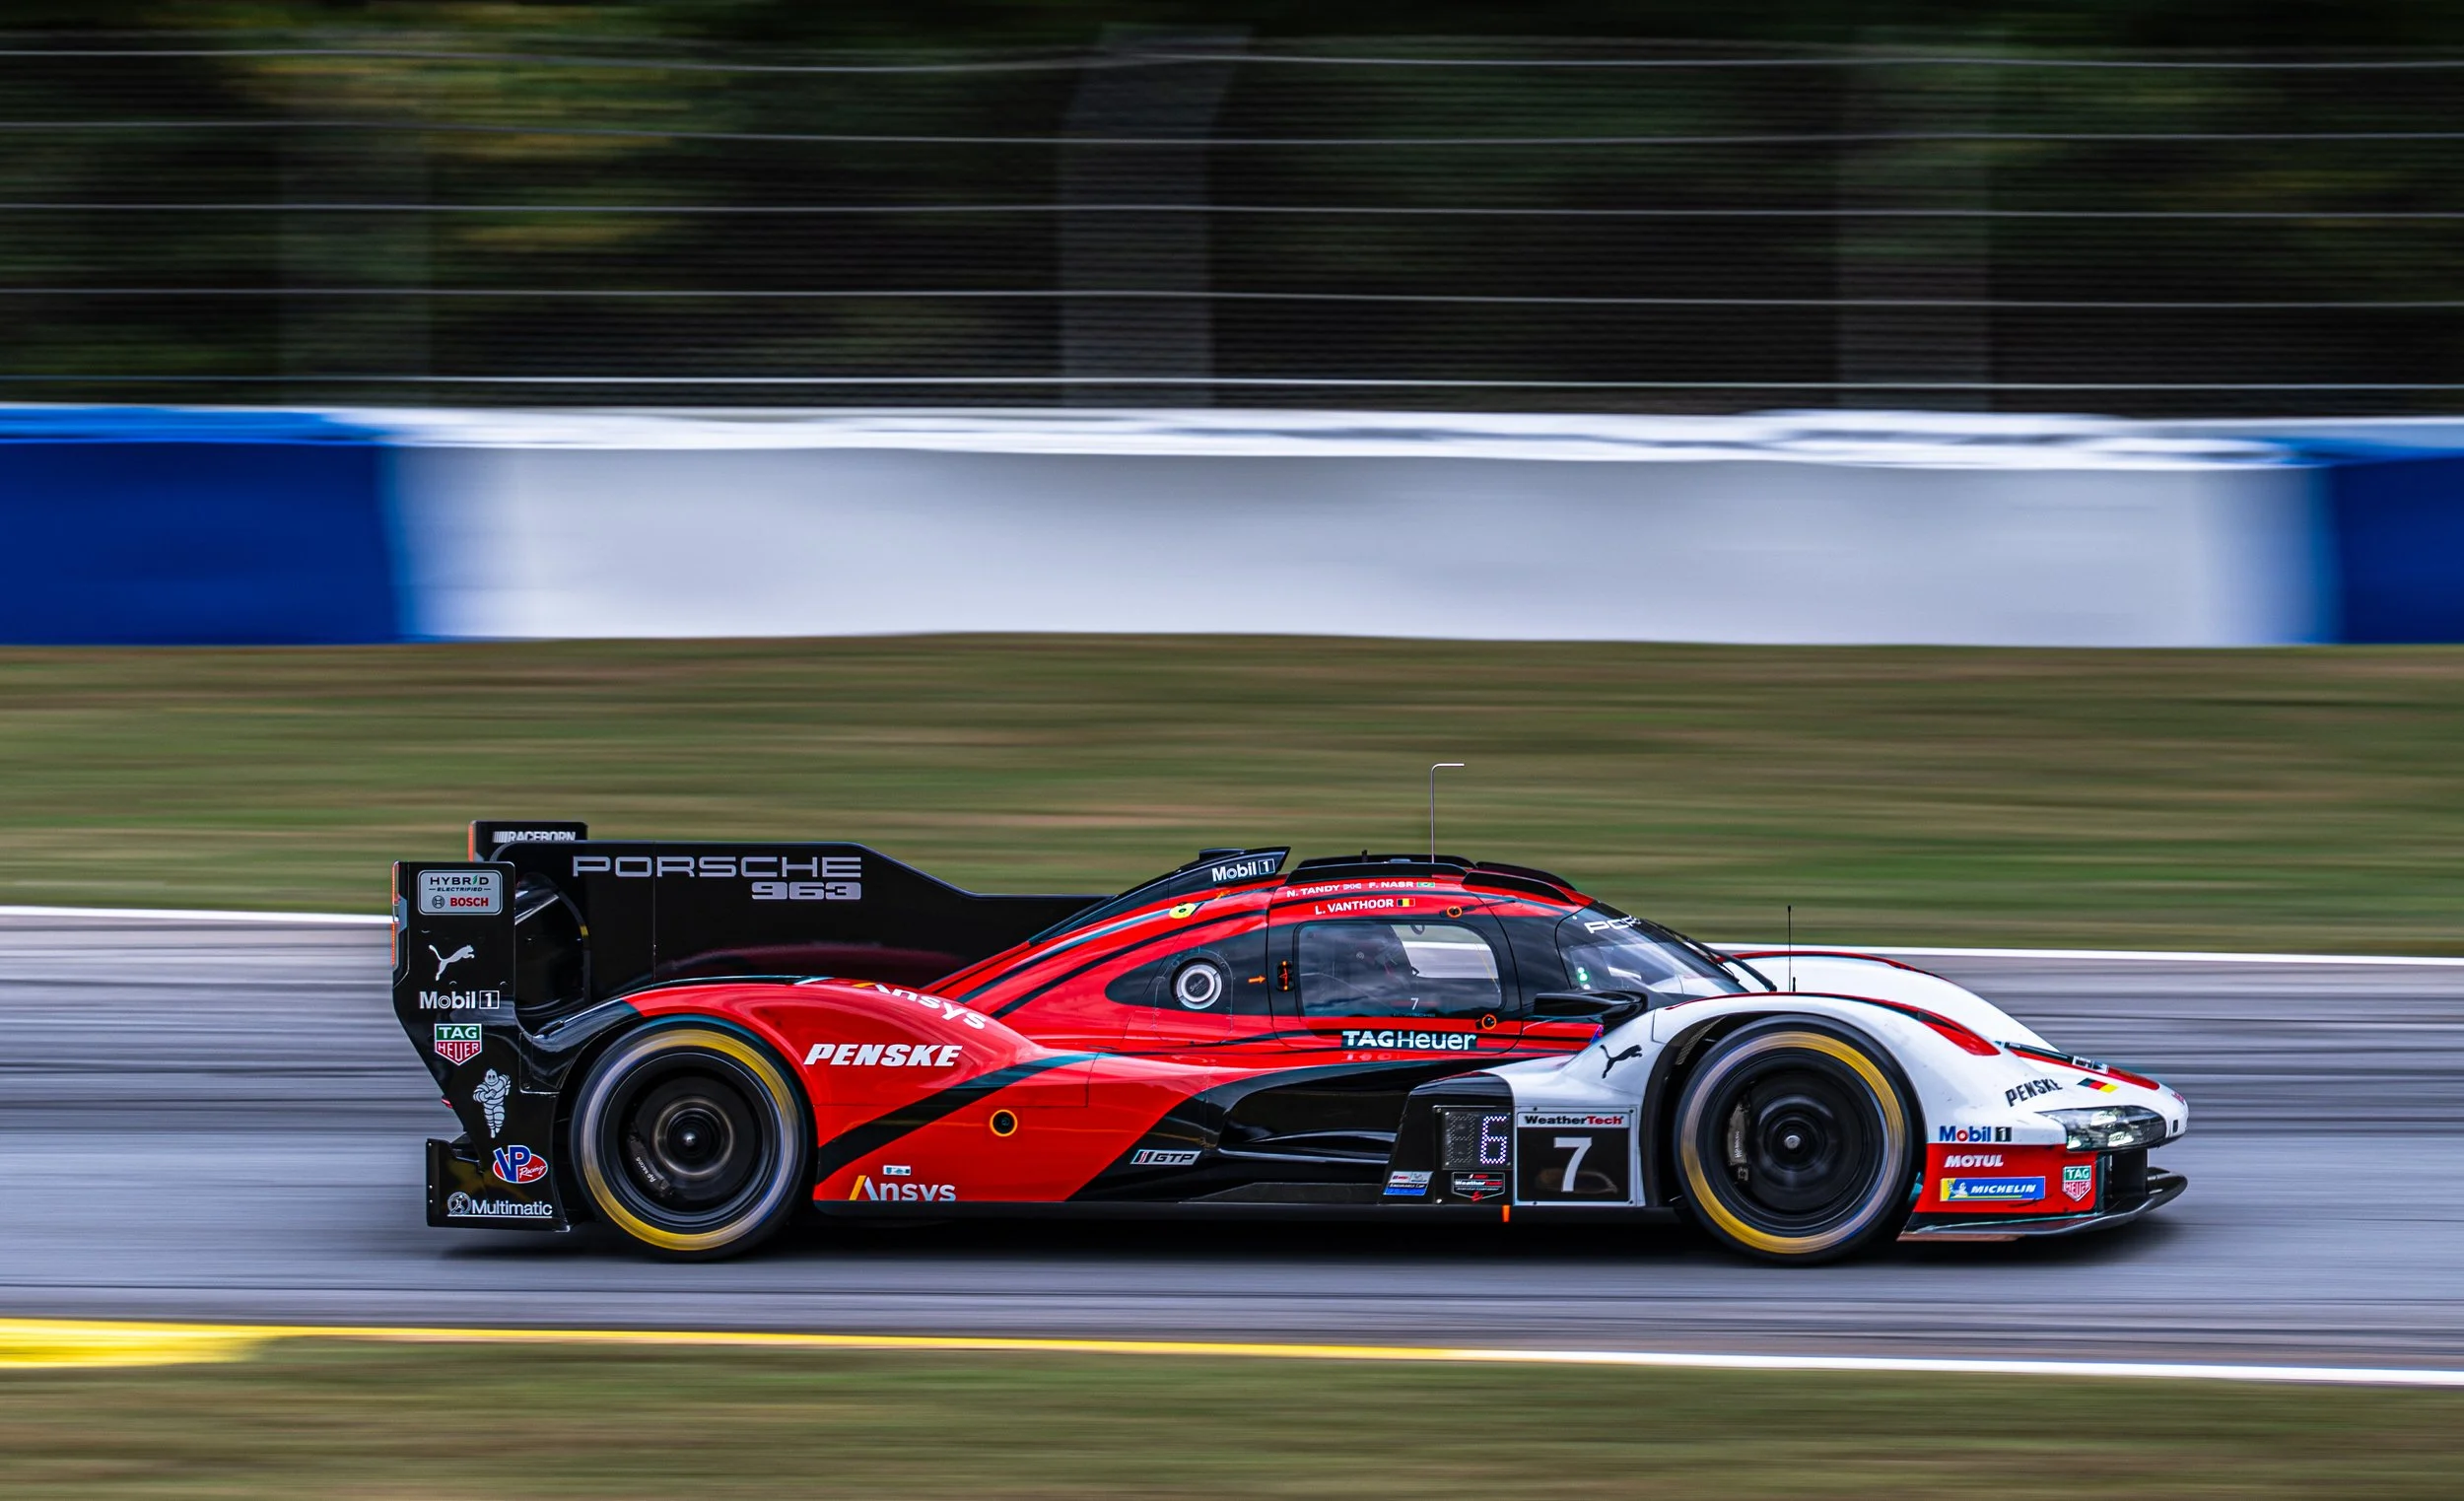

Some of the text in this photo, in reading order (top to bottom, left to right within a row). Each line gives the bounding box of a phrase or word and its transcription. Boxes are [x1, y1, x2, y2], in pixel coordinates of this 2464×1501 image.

[573, 855, 861, 877] PORSCHE
[1211, 861, 1257, 882] Mobil
[430, 875, 490, 886] HYBRID
[752, 882, 861, 900] 963
[1286, 884, 1340, 898] N. TANDY
[449, 898, 489, 907] BOSCH
[1315, 898, 1395, 916] L. VANTHOOR
[419, 990, 476, 1009] Mobil
[1410, 997, 1419, 1010] 7
[439, 1027, 477, 1039] TAG
[438, 1043, 479, 1062] HEUER
[803, 1044, 963, 1067] PENSKE
[2005, 1078, 2063, 1108] PENSKE
[1525, 1116, 1623, 1126] WeatherTech
[1479, 1116, 1508, 1165] 6
[1939, 1126, 1991, 1142] Mobil
[493, 1145, 531, 1183] VP
[1152, 1153, 1196, 1163] GTP
[1553, 1136, 1593, 1193] 7
[1944, 1154, 2004, 1168] MOTUL
[518, 1164, 547, 1178] Racing
[2066, 1169, 2089, 1180] TAG
[1971, 1185, 2036, 1194] MICHELIN
[2064, 1181, 2090, 1199] HEUER
[472, 1199, 552, 1215] Multimatic
